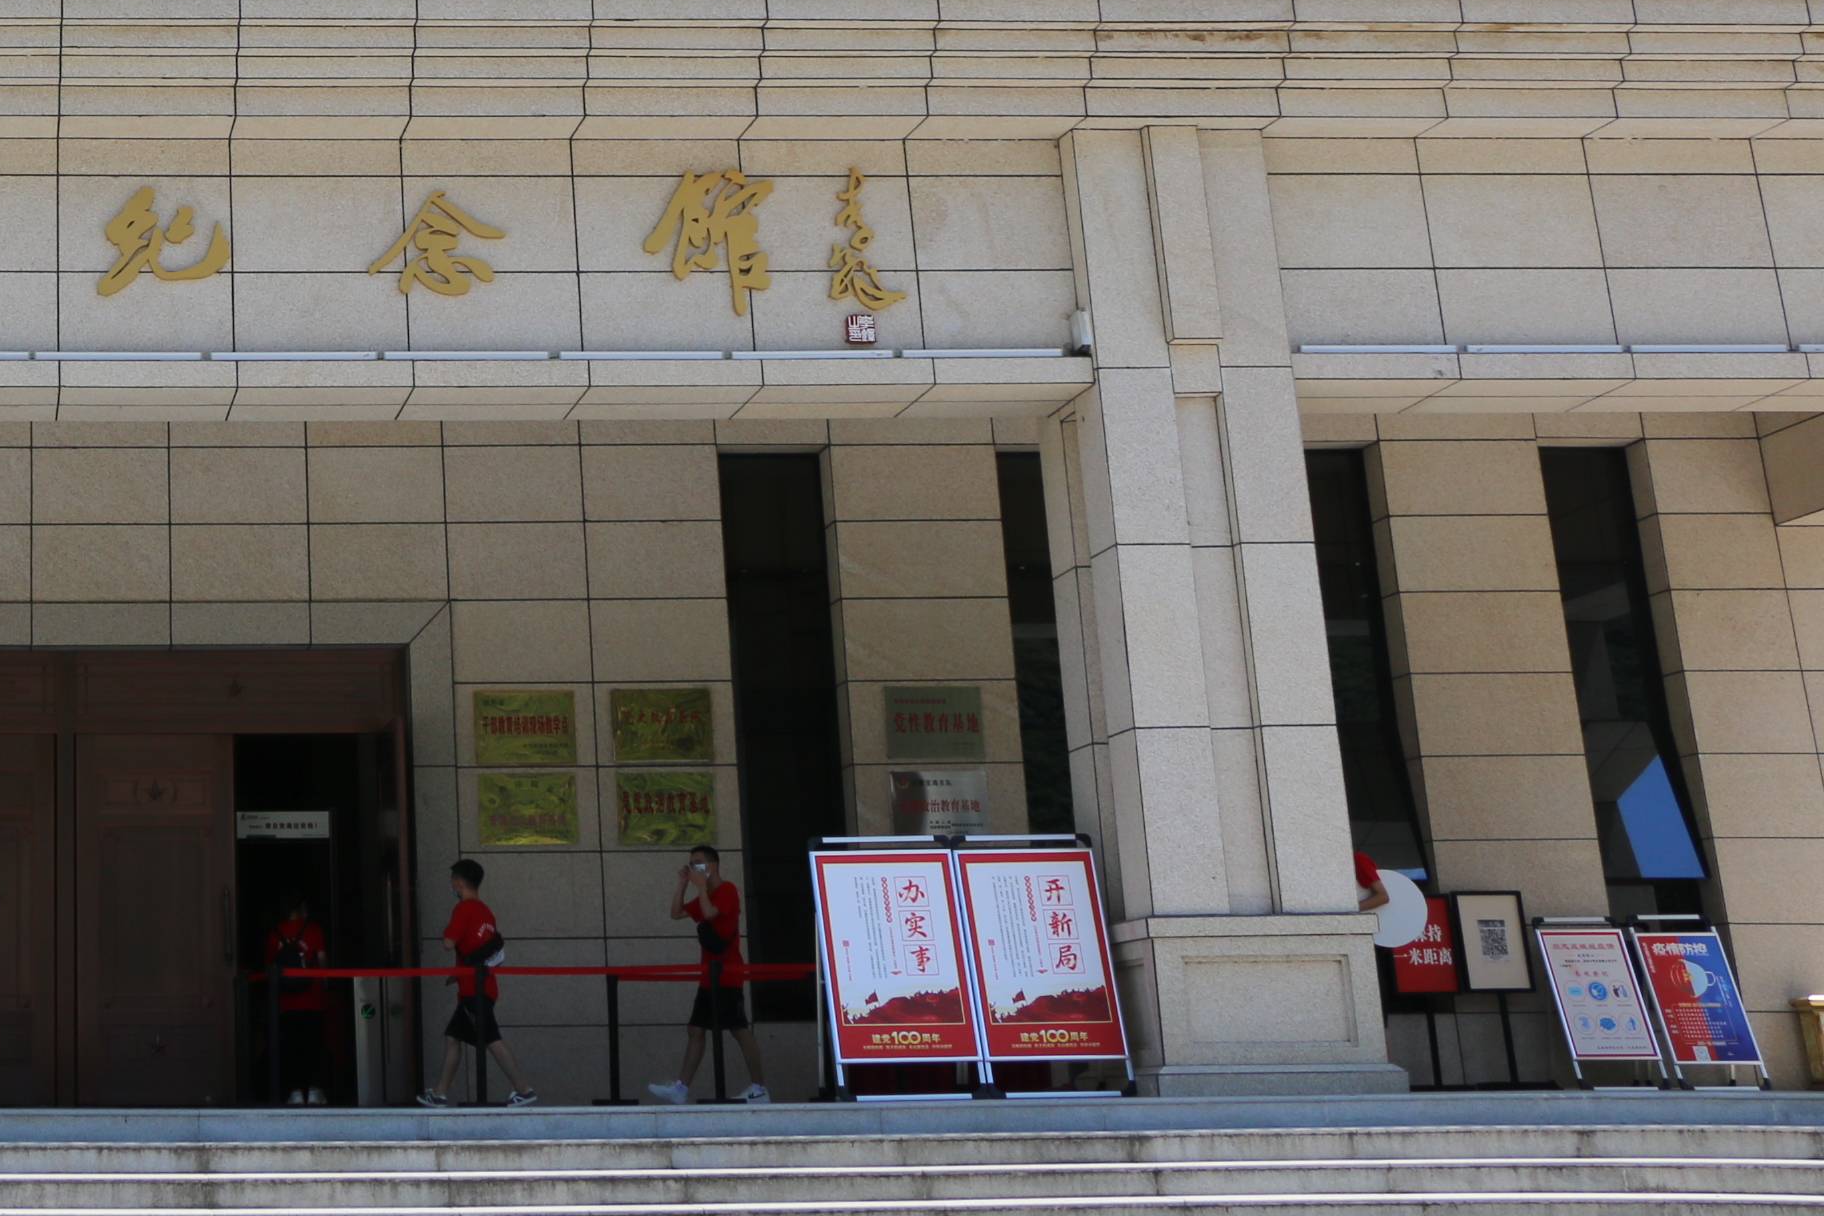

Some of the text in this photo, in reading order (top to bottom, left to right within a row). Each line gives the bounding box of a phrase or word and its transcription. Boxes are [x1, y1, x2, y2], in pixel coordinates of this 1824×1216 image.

[894, 712, 981, 734] 党性教育基地
[898, 878, 931, 974] 办实事
[1044, 878, 1078, 971] 开新局
[1393, 948, 1454, 966] 一米距离
[871, 1030, 941, 1045] 建党100周年
[1019, 1029, 1089, 1043] 建党100周年
